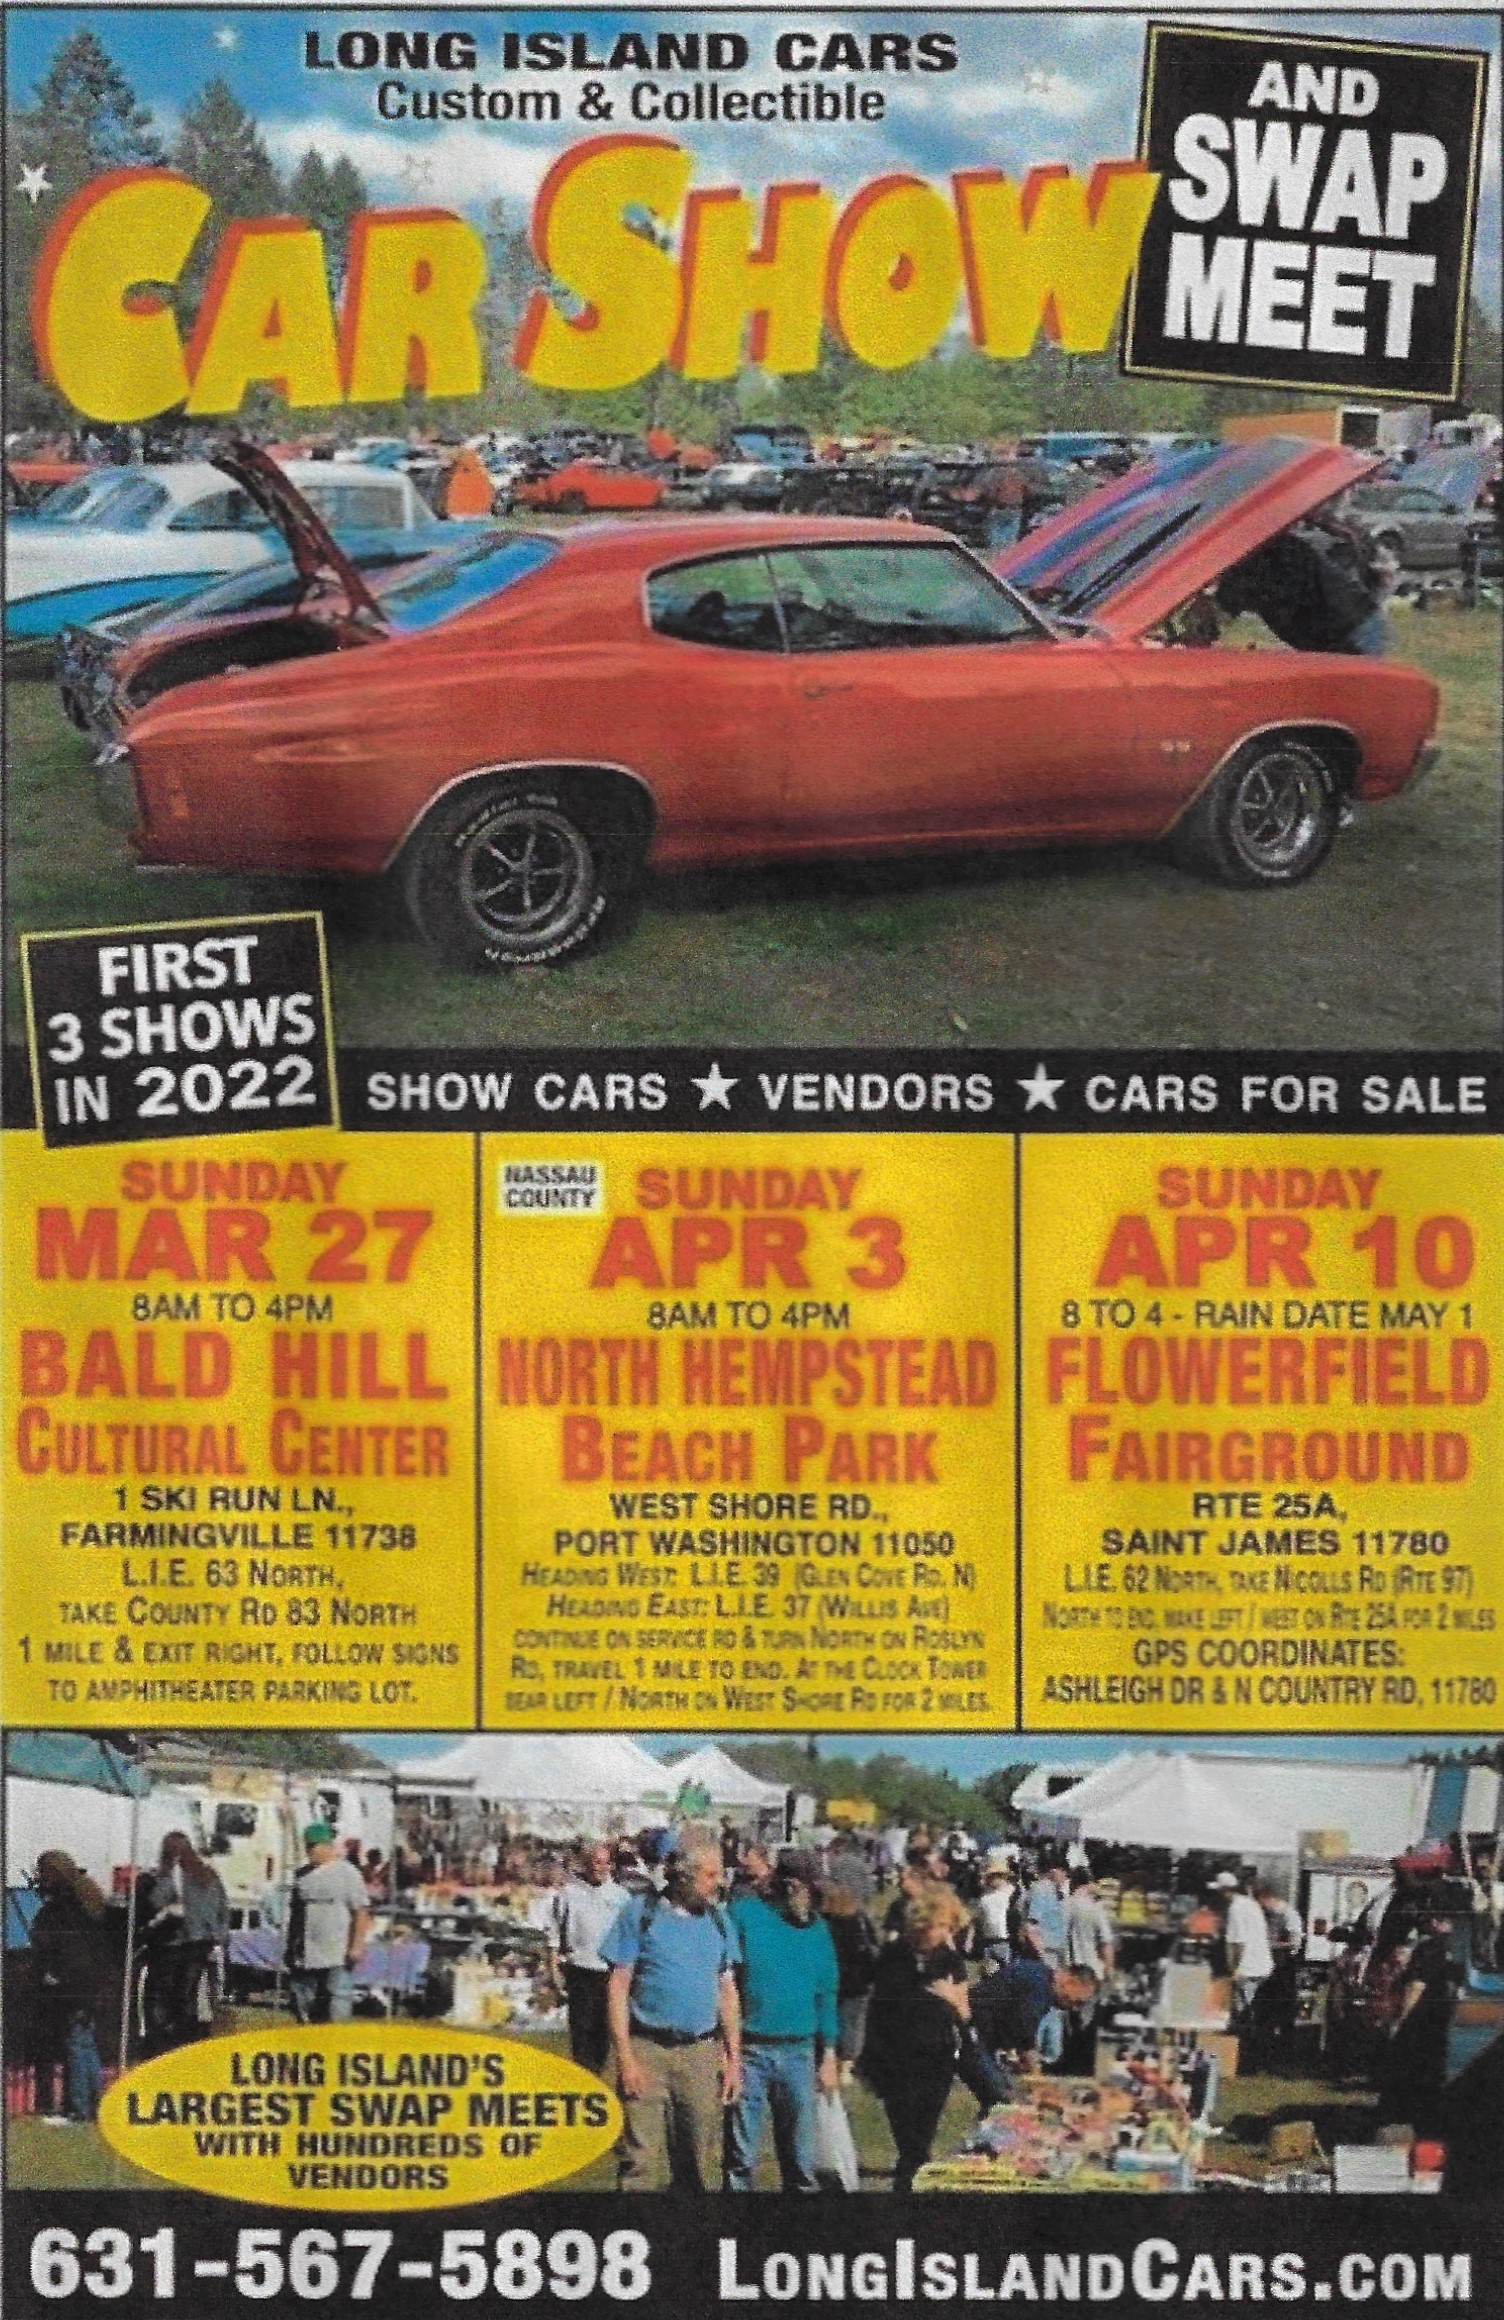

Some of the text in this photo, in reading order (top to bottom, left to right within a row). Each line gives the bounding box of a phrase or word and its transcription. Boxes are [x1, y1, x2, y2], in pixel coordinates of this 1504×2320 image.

[305, 30, 959, 73] LONG ISLAND CARS
[378, 81, 886, 122] Custom & Collectible
[1248, 61, 1380, 116] AND
[1168, 114, 1449, 239] SWAP
[32, 133, 1161, 422] CAR SHOW
[1163, 231, 1438, 359] MEET
[99, 935, 259, 996] FIRST
[48, 993, 316, 1063] 3 SHOWS
[56, 1056, 317, 1125] IN 2022
[368, 1073, 667, 1110] SHOW CARS
[759, 1074, 993, 1111] VENDORS
[1086, 1075, 1486, 1113] CARS FOR SALE
[121, 1160, 346, 1205] SUNDAY
[506, 1188, 595, 1208] COUNTY
[637, 1168, 860, 1212] SUNDAY
[1158, 1167, 1382, 1210] SUNDAY
[37, 1207, 433, 1283] MAR 27
[591, 1212, 906, 1290] APR 3
[1095, 1214, 1474, 1292] APR 10
[131, 1292, 333, 1323] 8AM TO 4PM
[647, 1301, 849, 1331] 8AM TO 4PM
[1062, 1298, 1471, 1329] 8 TO 4 RAIN DATE MAY 1
[21, 1329, 448, 1402] BALD HILL
[499, 1337, 997, 1408] NORTH HEMPSTEAD
[1048, 1337, 1489, 1406] FLOWERFIELD
[115, 1486, 126, 1510] 1
[141, 1485, 196, 1512] SKI
[210, 1486, 280, 1511] RUN
[610, 1493, 698, 1520] WEST
[709, 1493, 817, 1520] SHORE
[1193, 1492, 1347, 1521] RTE 25A,
[62, 1522, 416, 1550] FARMINGVILLE 11738
[555, 1530, 638, 1556] PORT
[649, 1529, 860, 1557] WASHINGTON
[1102, 1527, 1449, 1556] SAINT JAMES 11780
[1133, 1638, 1404, 1668] GPS COORDINATES:
[47, 1679, 417, 1704] TO AMPHITHEATER PARKING LOT.
[232, 2052, 504, 2087] LONG ISLAND'S
[128, 2092, 608, 2127] LARGEST SWAP MEETS
[195, 2132, 541, 2157] WITH HUNDREDS OF
[288, 2163, 448, 2189] VENDORS
[31, 2228, 651, 2300] 631-567-5898
